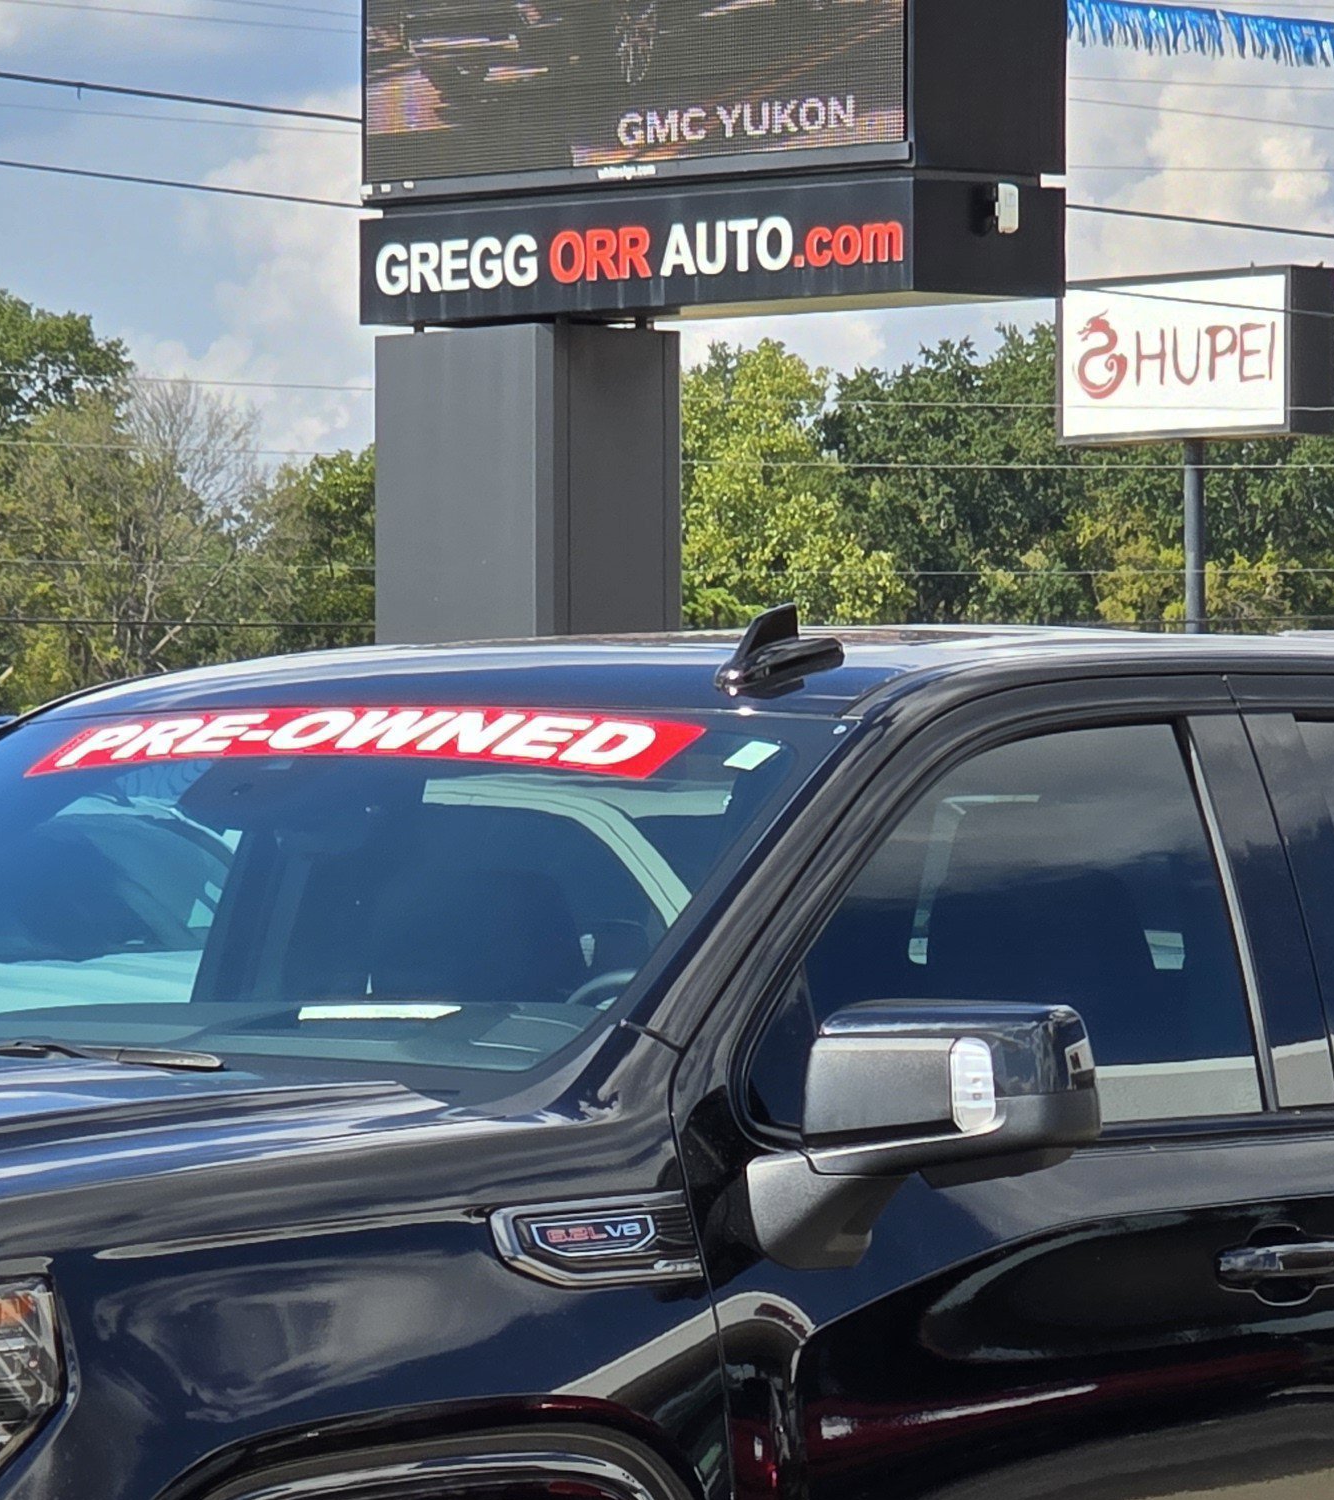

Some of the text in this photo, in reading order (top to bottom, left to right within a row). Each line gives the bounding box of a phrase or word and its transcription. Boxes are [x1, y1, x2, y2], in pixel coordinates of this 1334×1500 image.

[616, 95, 856, 147] GMC YUKON
[375, 216, 904, 295] GREGG ORR AUTO.com
[1135, 320, 1276, 387] HUPEI
[57, 709, 657, 766] PRE-OWNED
